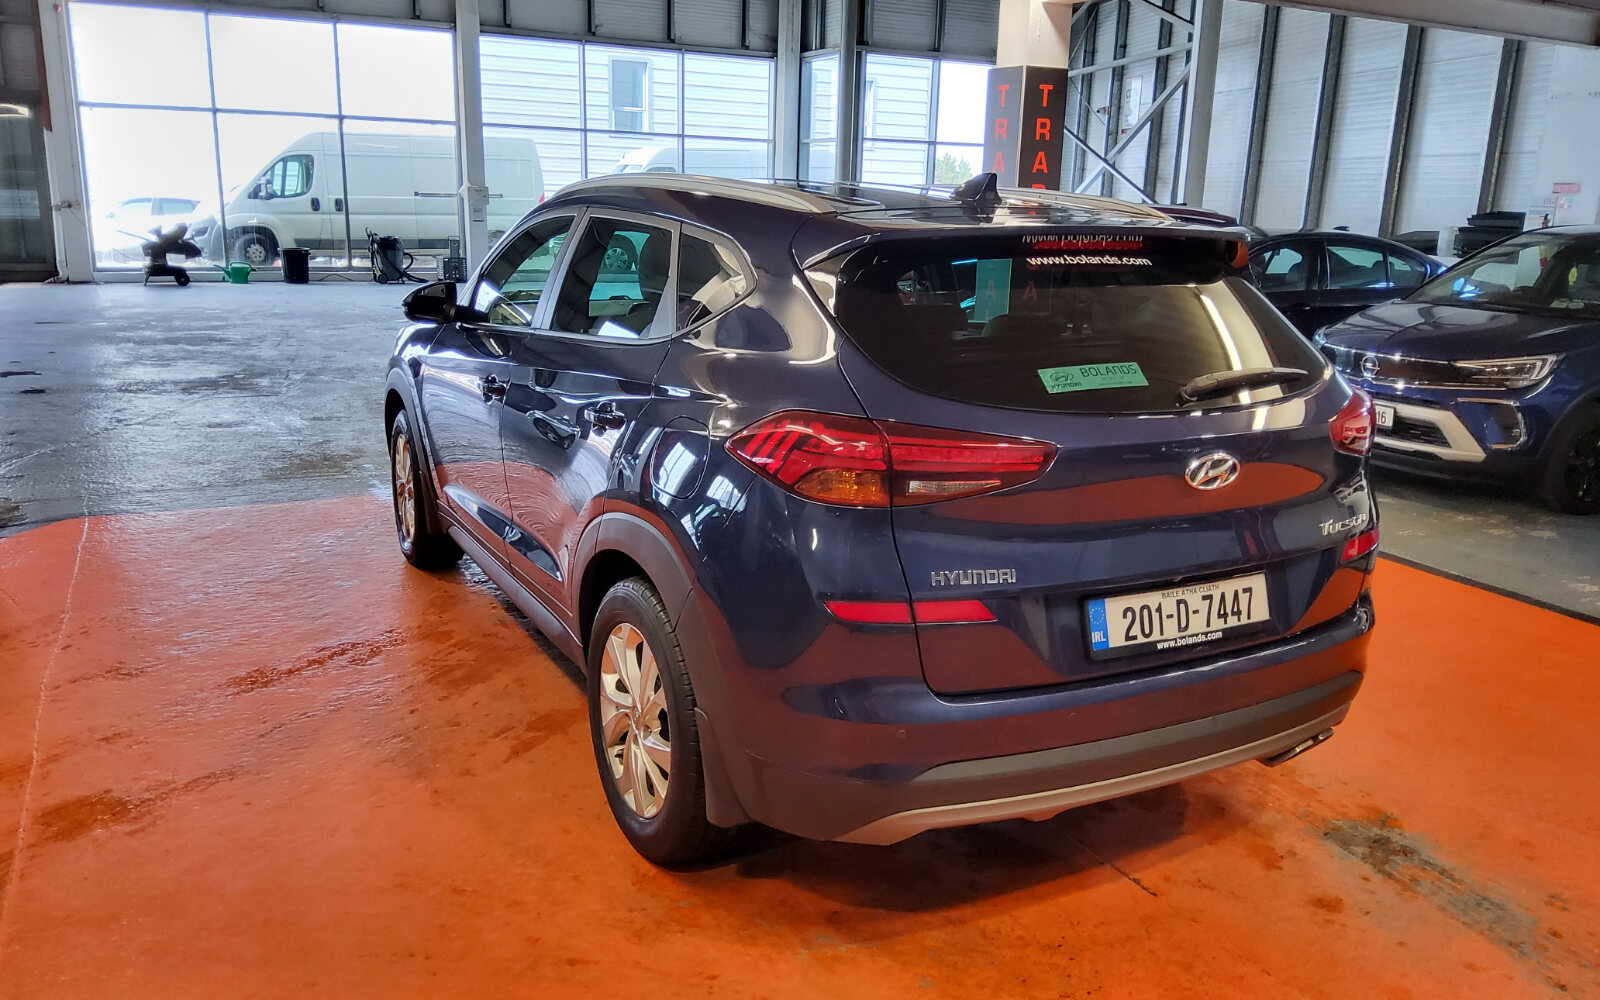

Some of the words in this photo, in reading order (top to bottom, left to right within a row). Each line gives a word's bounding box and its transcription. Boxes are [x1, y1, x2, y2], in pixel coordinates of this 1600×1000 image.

[992, 84, 1010, 188] TRA
[1026, 254, 1153, 266] www.bolands.com
[1080, 364, 1138, 378] BOLANDS
[931, 568, 1017, 587] HYUNDAI
[1161, 591, 1180, 600] BAILE
[1122, 586, 1253, 643] 201-D-7447
[1091, 631, 1107, 644] IRL
[1156, 630, 1223, 650] www.bolands.com
